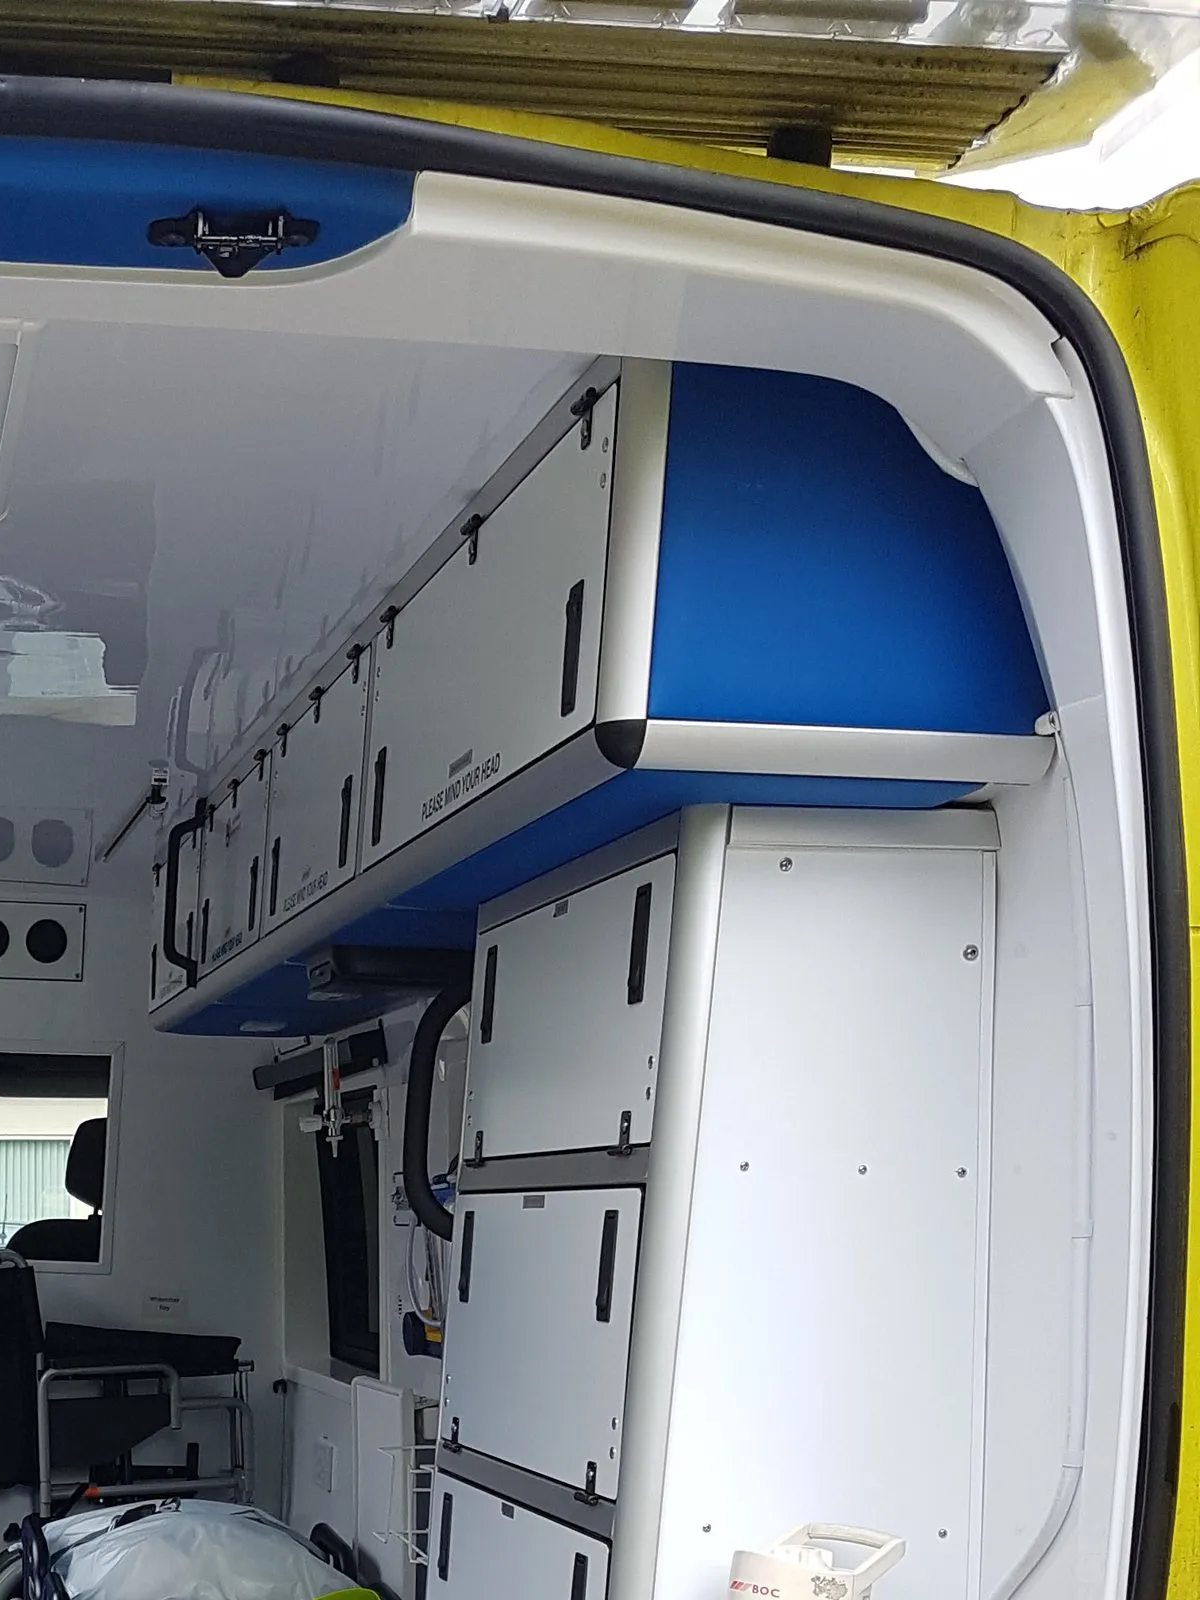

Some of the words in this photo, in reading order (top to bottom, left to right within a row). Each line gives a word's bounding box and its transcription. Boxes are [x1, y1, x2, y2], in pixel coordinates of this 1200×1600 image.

[421, 790, 444, 822] PLEASE
[444, 780, 460, 806] MIND
[461, 766, 480, 795] YOUR
[480, 753, 500, 782] HEAD
[752, 1585, 781, 1598] BOC
